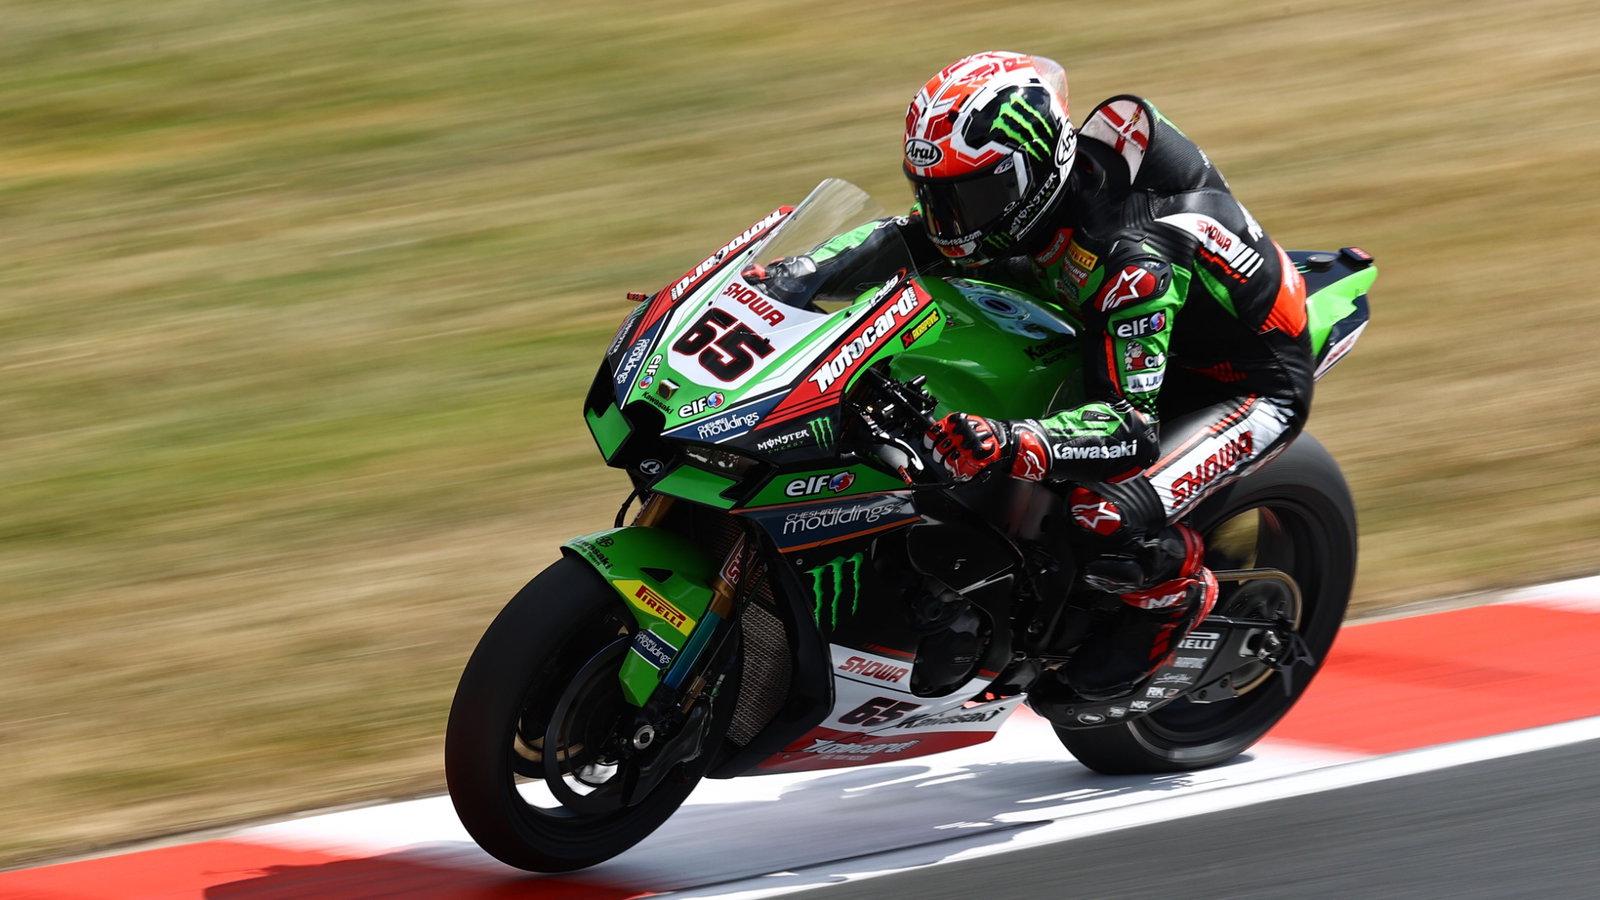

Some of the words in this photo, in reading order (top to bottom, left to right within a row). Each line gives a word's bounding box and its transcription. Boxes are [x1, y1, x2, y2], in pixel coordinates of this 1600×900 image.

[722, 282, 786, 327] SHOWA
[1117, 317, 1149, 338] elf
[672, 307, 776, 383] 65
[645, 354, 664, 376] elf
[641, 391, 674, 415] Kawasaki
[678, 399, 708, 418] elf
[699, 412, 760, 440] mouldings
[757, 428, 810, 451] MONSTER
[1052, 440, 1137, 460] Kawasaki
[1171, 430, 1253, 509] SHOWA
[785, 474, 830, 497] elf
[782, 503, 894, 535] mouldings
[635, 585, 687, 628] PIRELLI
[838, 656, 909, 683] SHOWA
[838, 696, 922, 727] 65
